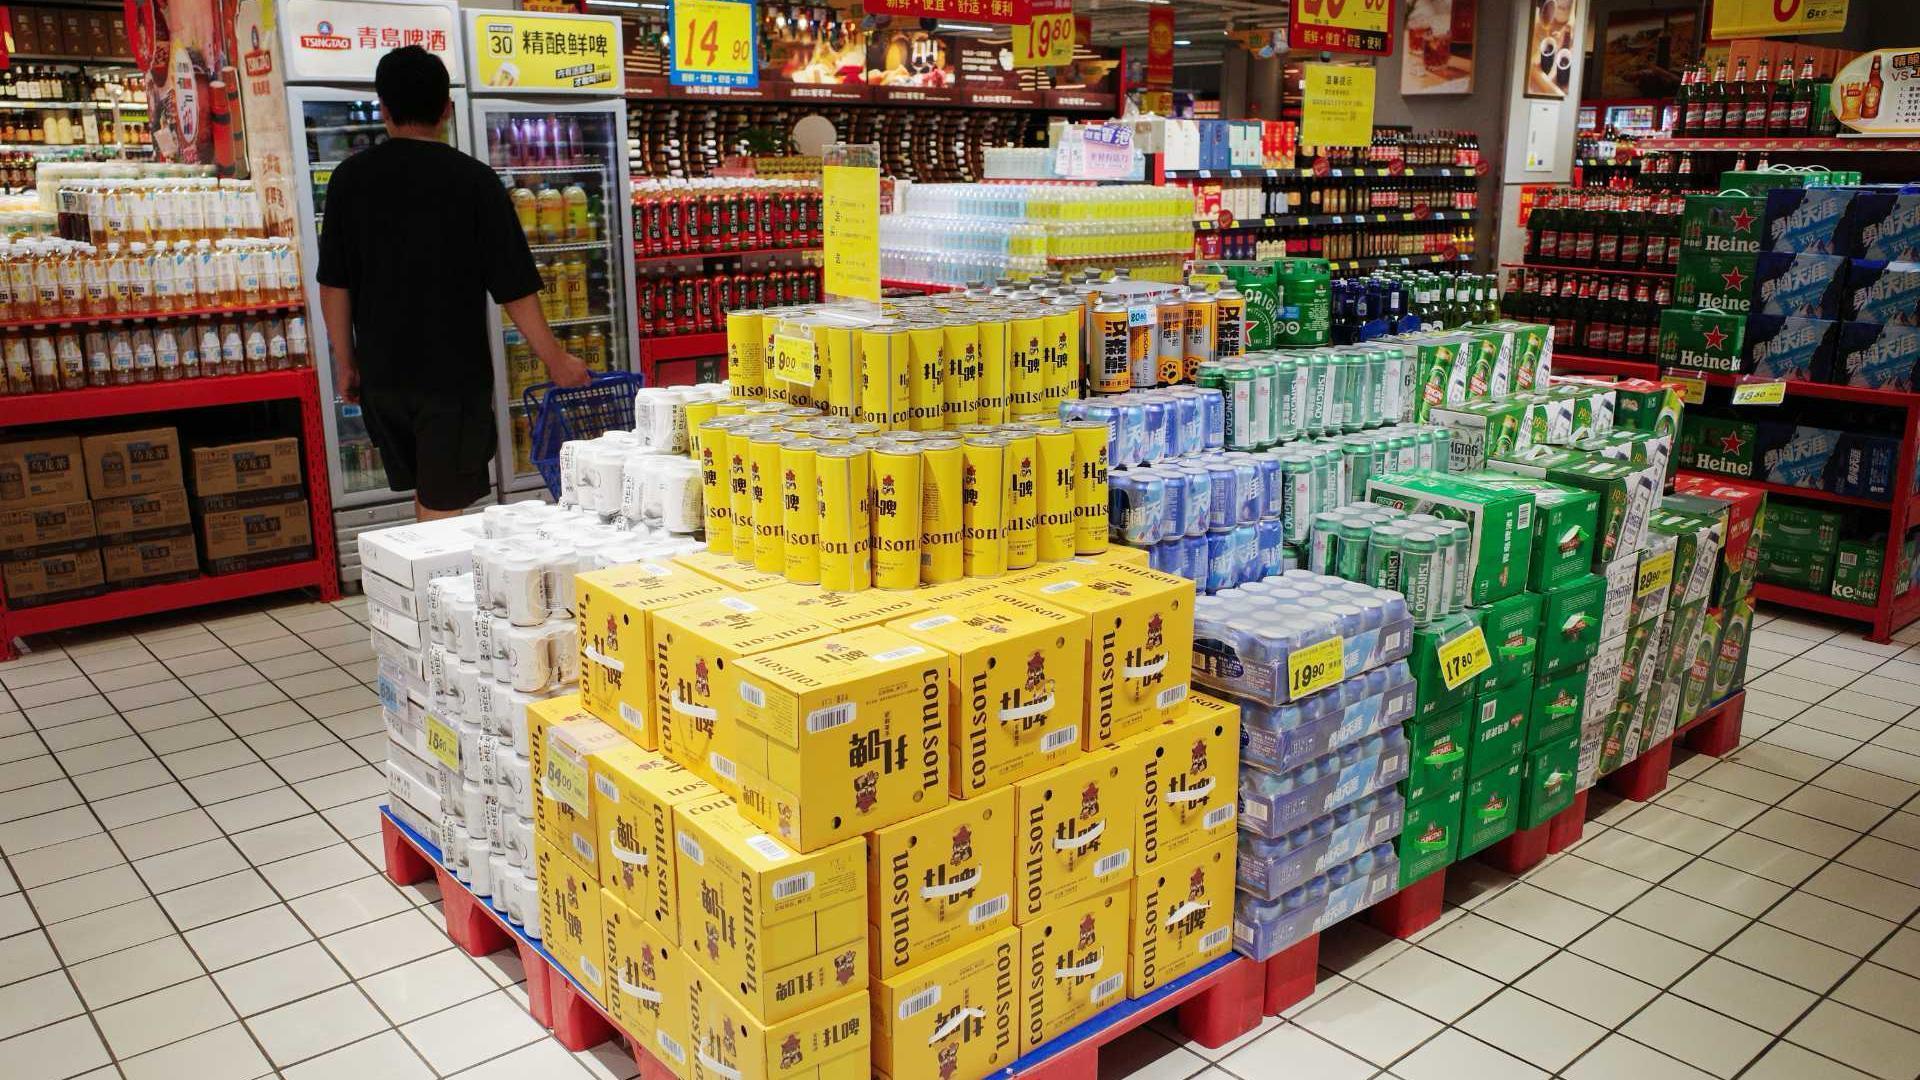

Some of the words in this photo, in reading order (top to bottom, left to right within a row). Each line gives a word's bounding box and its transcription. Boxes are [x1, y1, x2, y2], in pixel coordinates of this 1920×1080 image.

[304, 37, 349, 49] TSINGTAO
[491, 36, 512, 54] 30
[522, 30, 608, 58] 精酿鲜啤
[1771, 198, 1838, 240] 勇闯天涯
[1761, 259, 1828, 300] 勇闯天涯
[1753, 326, 1816, 362] 勇闯天涯
[1414, 562, 1430, 613] TSINGTAO
[657, 641, 673, 754] coulson
[922, 668, 942, 792] coulson
[969, 670, 988, 790] coulson
[1099, 630, 1117, 741] coulson
[848, 727, 909, 775] 扎啤
[654, 803, 670, 918] coulson
[1027, 802, 1045, 915] coulson
[1143, 758, 1158, 865] coulson
[538, 855, 554, 950] coulson
[741, 870, 758, 994] coulson
[890, 849, 910, 968] coulson
[1143, 889, 1159, 990] coulson
[606, 918, 622, 1021] coulson
[995, 942, 1013, 1049] coulson
[1029, 939, 1045, 1046] coulson
